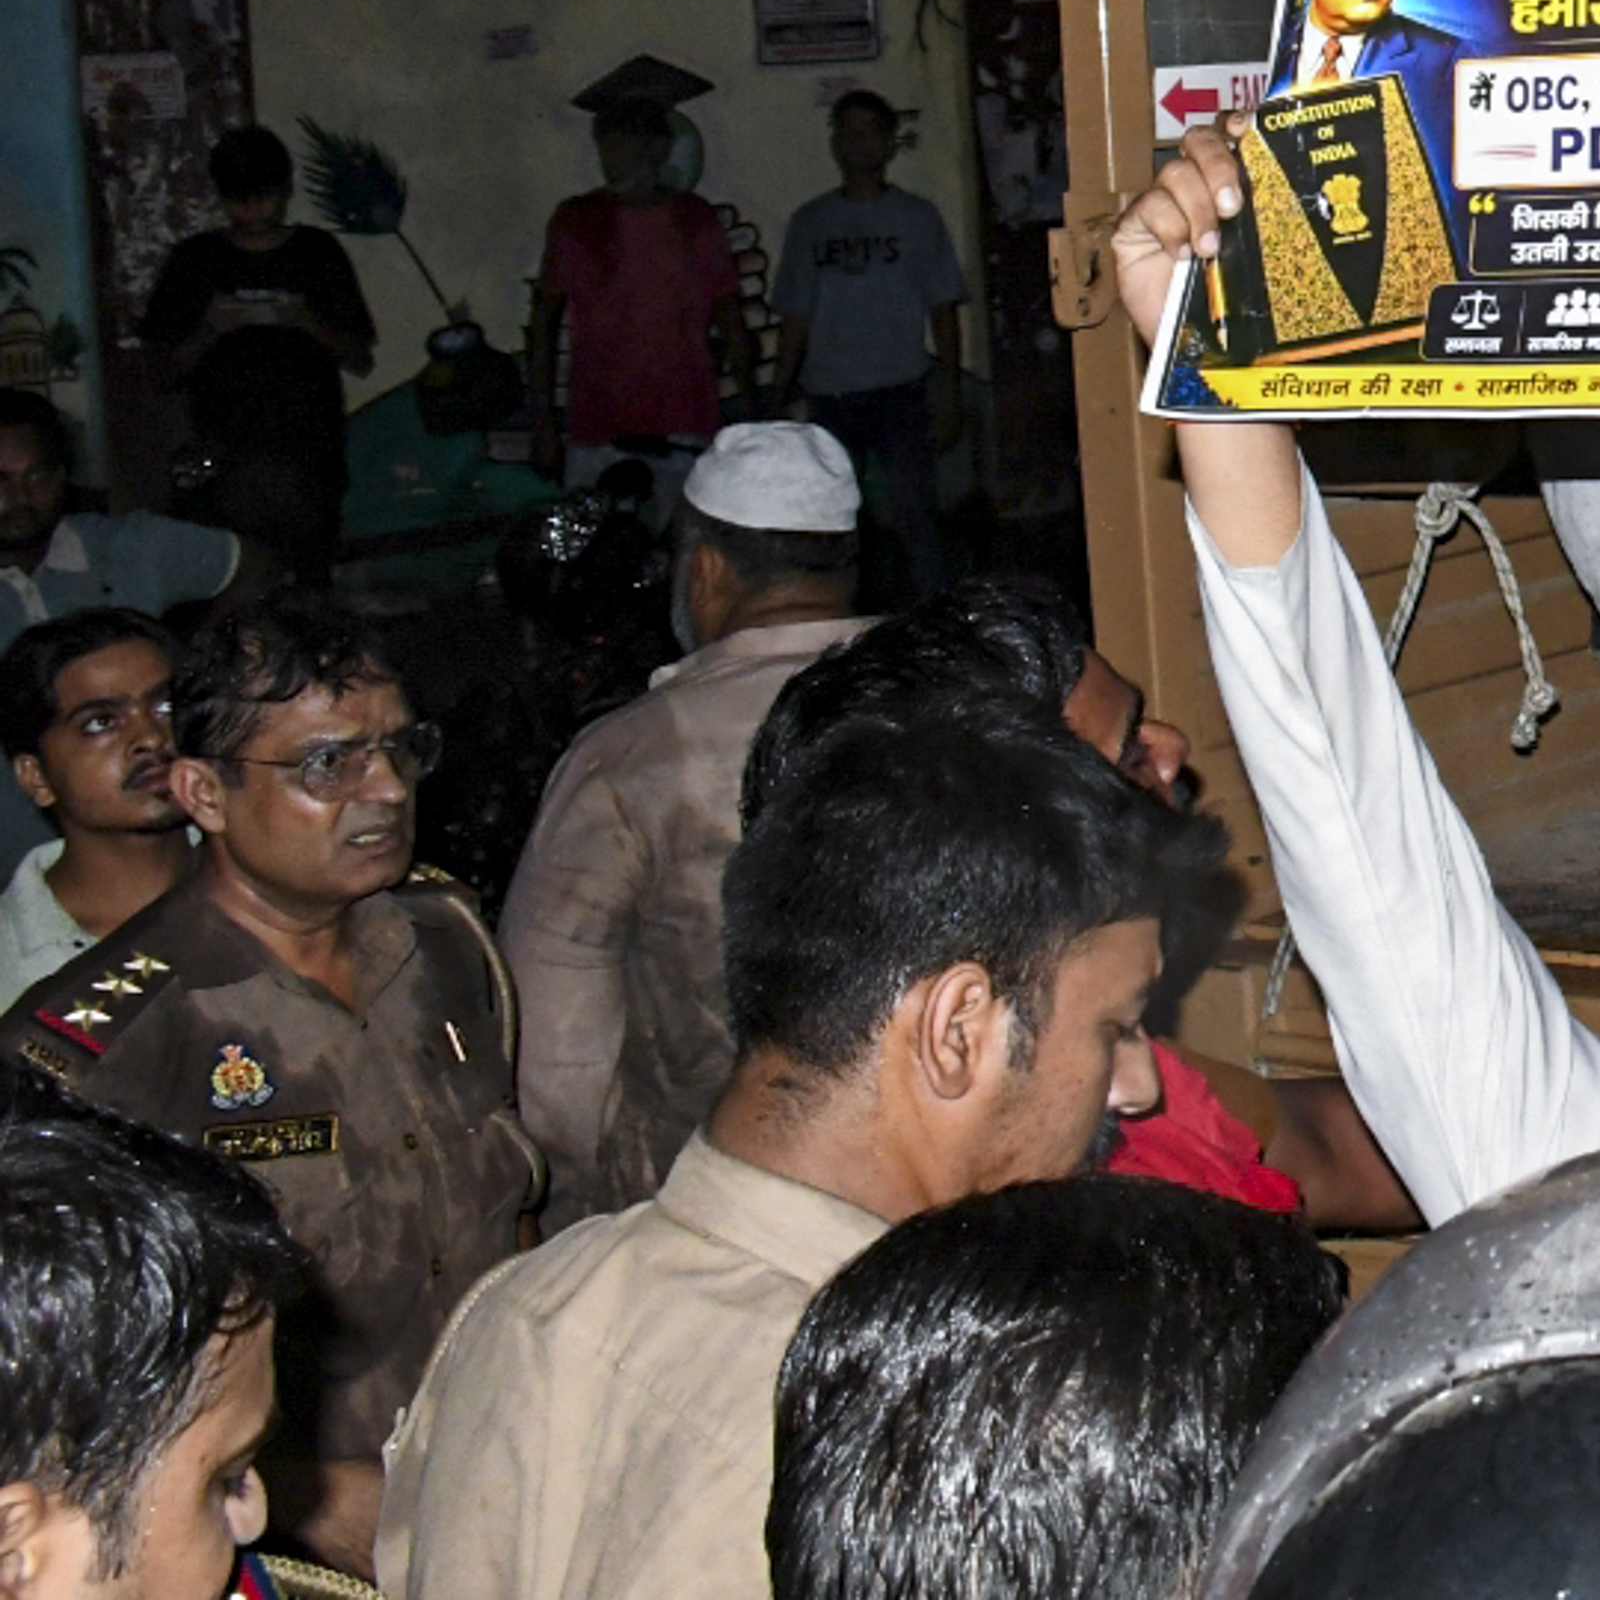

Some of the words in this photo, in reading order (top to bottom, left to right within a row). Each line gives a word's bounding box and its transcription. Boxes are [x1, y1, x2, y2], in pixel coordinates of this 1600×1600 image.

[1469, 73, 1497, 111] मैं
[1506, 76, 1590, 114] OBC,
[1264, 94, 1376, 131] CONSTITUTION
[1317, 124, 1335, 140] OF
[1309, 142, 1358, 165] INDIA
[1511, 201, 1590, 231] जिसकी
[1510, 233, 1569, 264] उतनी
[1261, 373, 1350, 397] संविधान
[1360, 373, 1392, 396] की
[1401, 378, 1442, 396] रक्षा
[1477, 372, 1577, 396] सामाजिक
